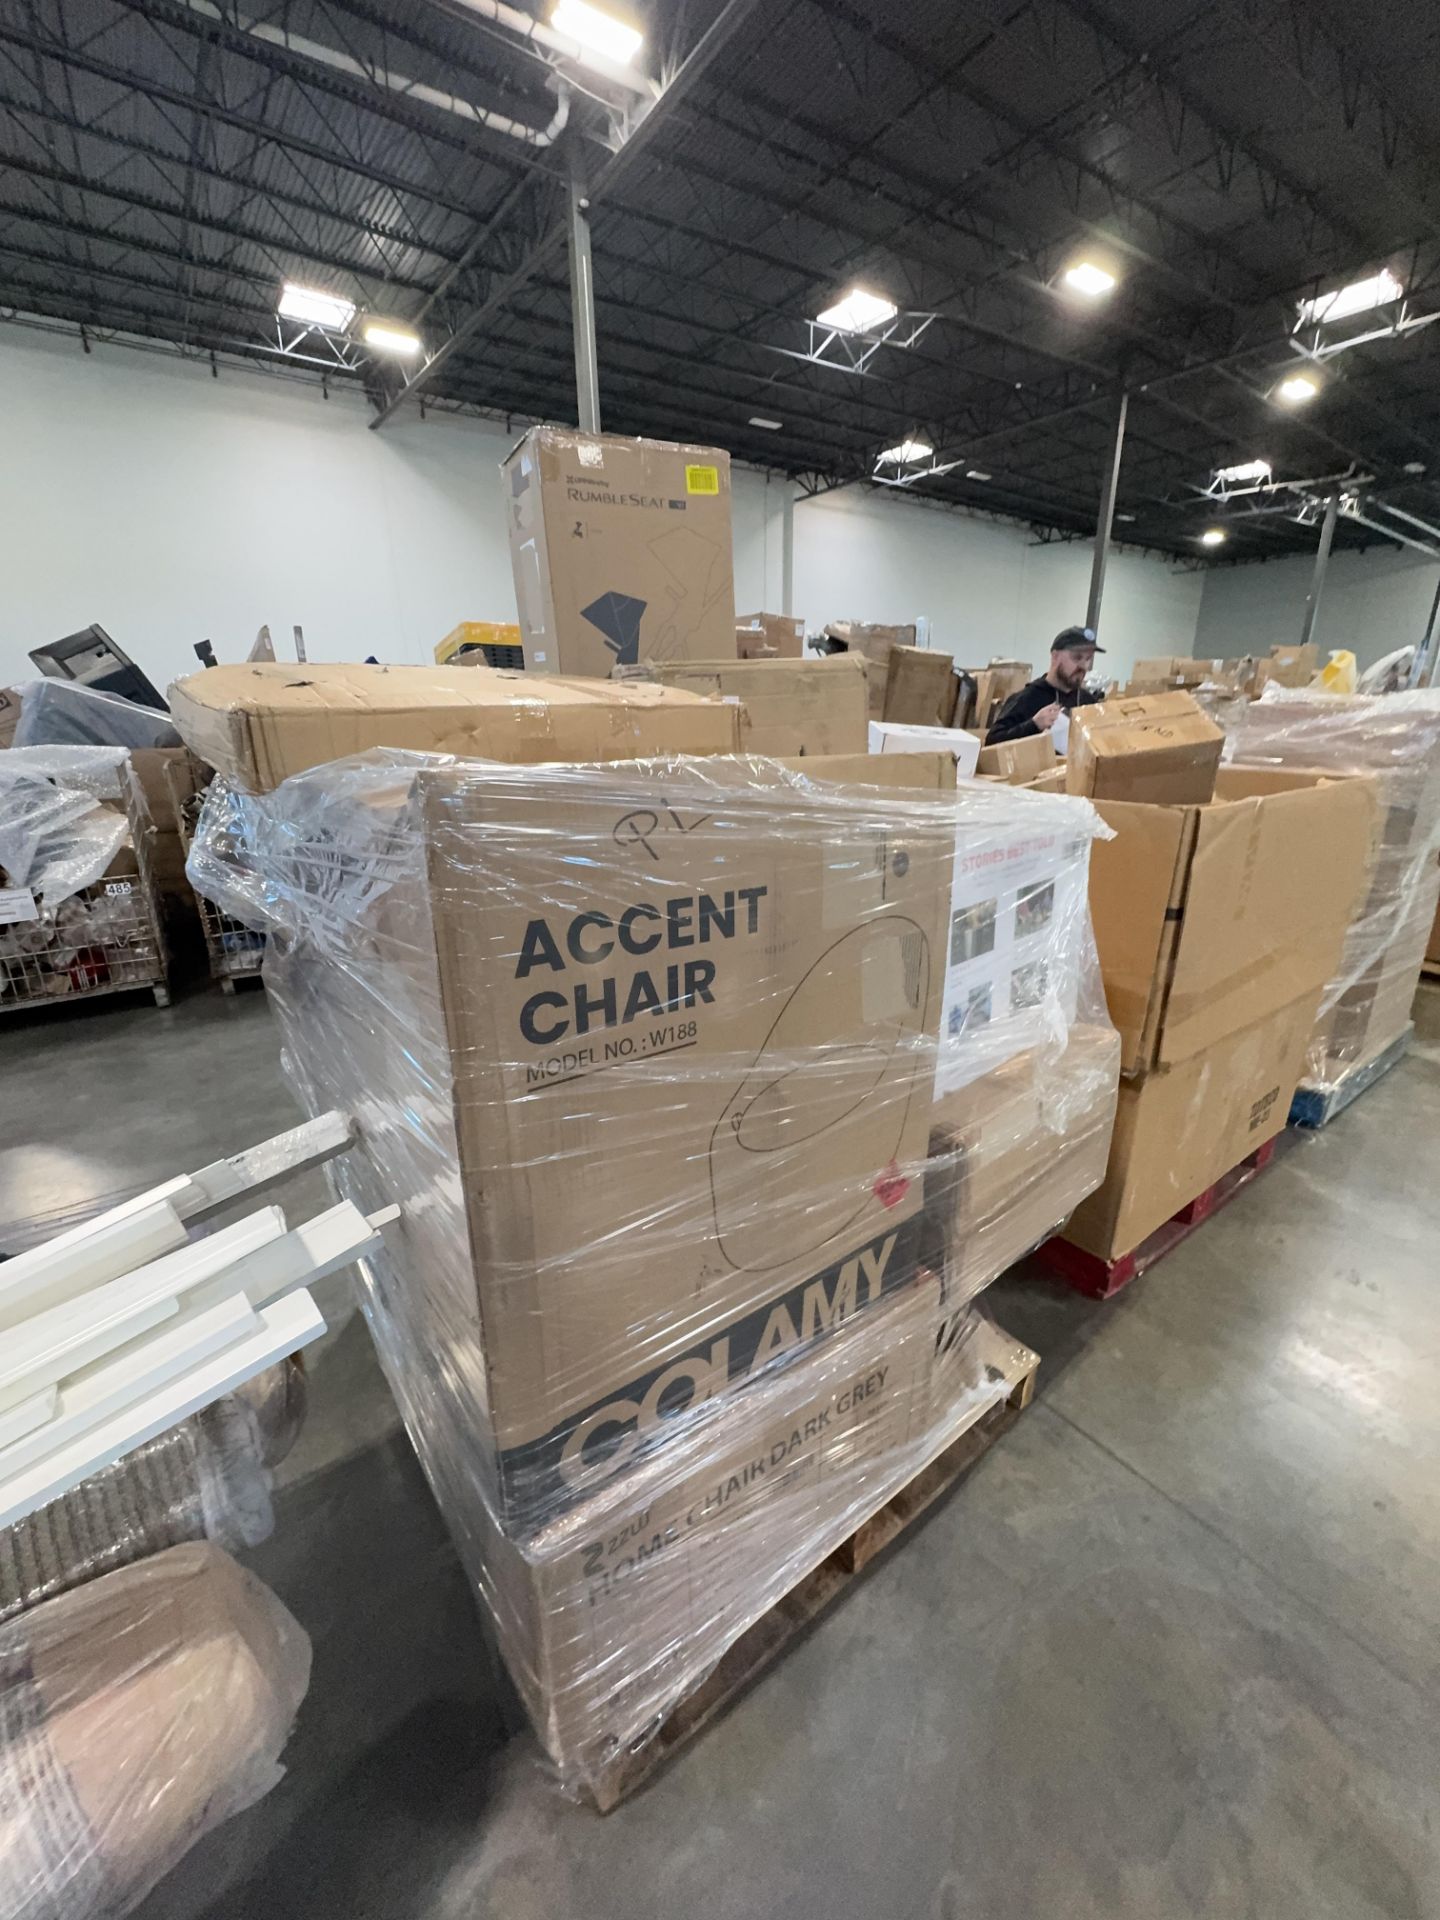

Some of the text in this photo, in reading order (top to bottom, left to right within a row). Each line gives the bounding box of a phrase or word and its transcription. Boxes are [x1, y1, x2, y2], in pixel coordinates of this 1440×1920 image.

[108, 883, 131, 894] 485
[514, 885, 768, 979] ACCENT
[519, 959, 716, 1045] CHAIR
[526, 1048, 600, 1084] MODEL
[649, 1020, 698, 1048] W188
[769, 1407, 833, 1467] DARK
[835, 1365, 889, 1416] GREY
